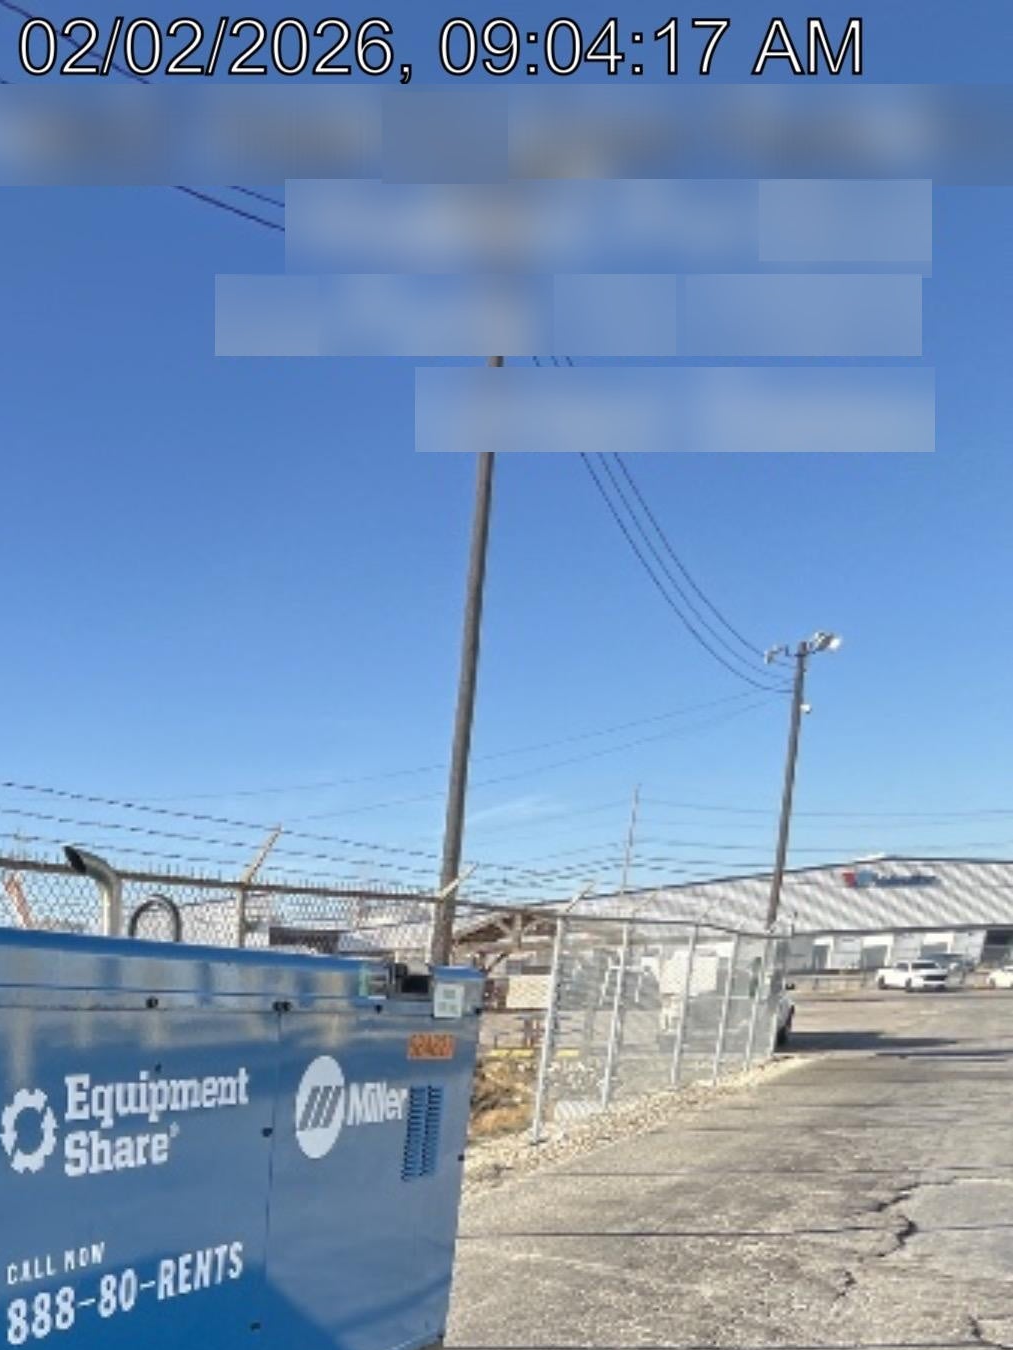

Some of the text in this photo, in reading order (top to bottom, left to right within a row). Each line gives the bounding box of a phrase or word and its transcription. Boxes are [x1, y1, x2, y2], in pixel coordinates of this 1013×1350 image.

[64, 1067, 250, 1129] Equipment
[346, 1080, 409, 1126] Miller
[6, 1240, 106, 1286] CALL NOW
[6, 1240, 245, 1346] 888-80-RENTS
